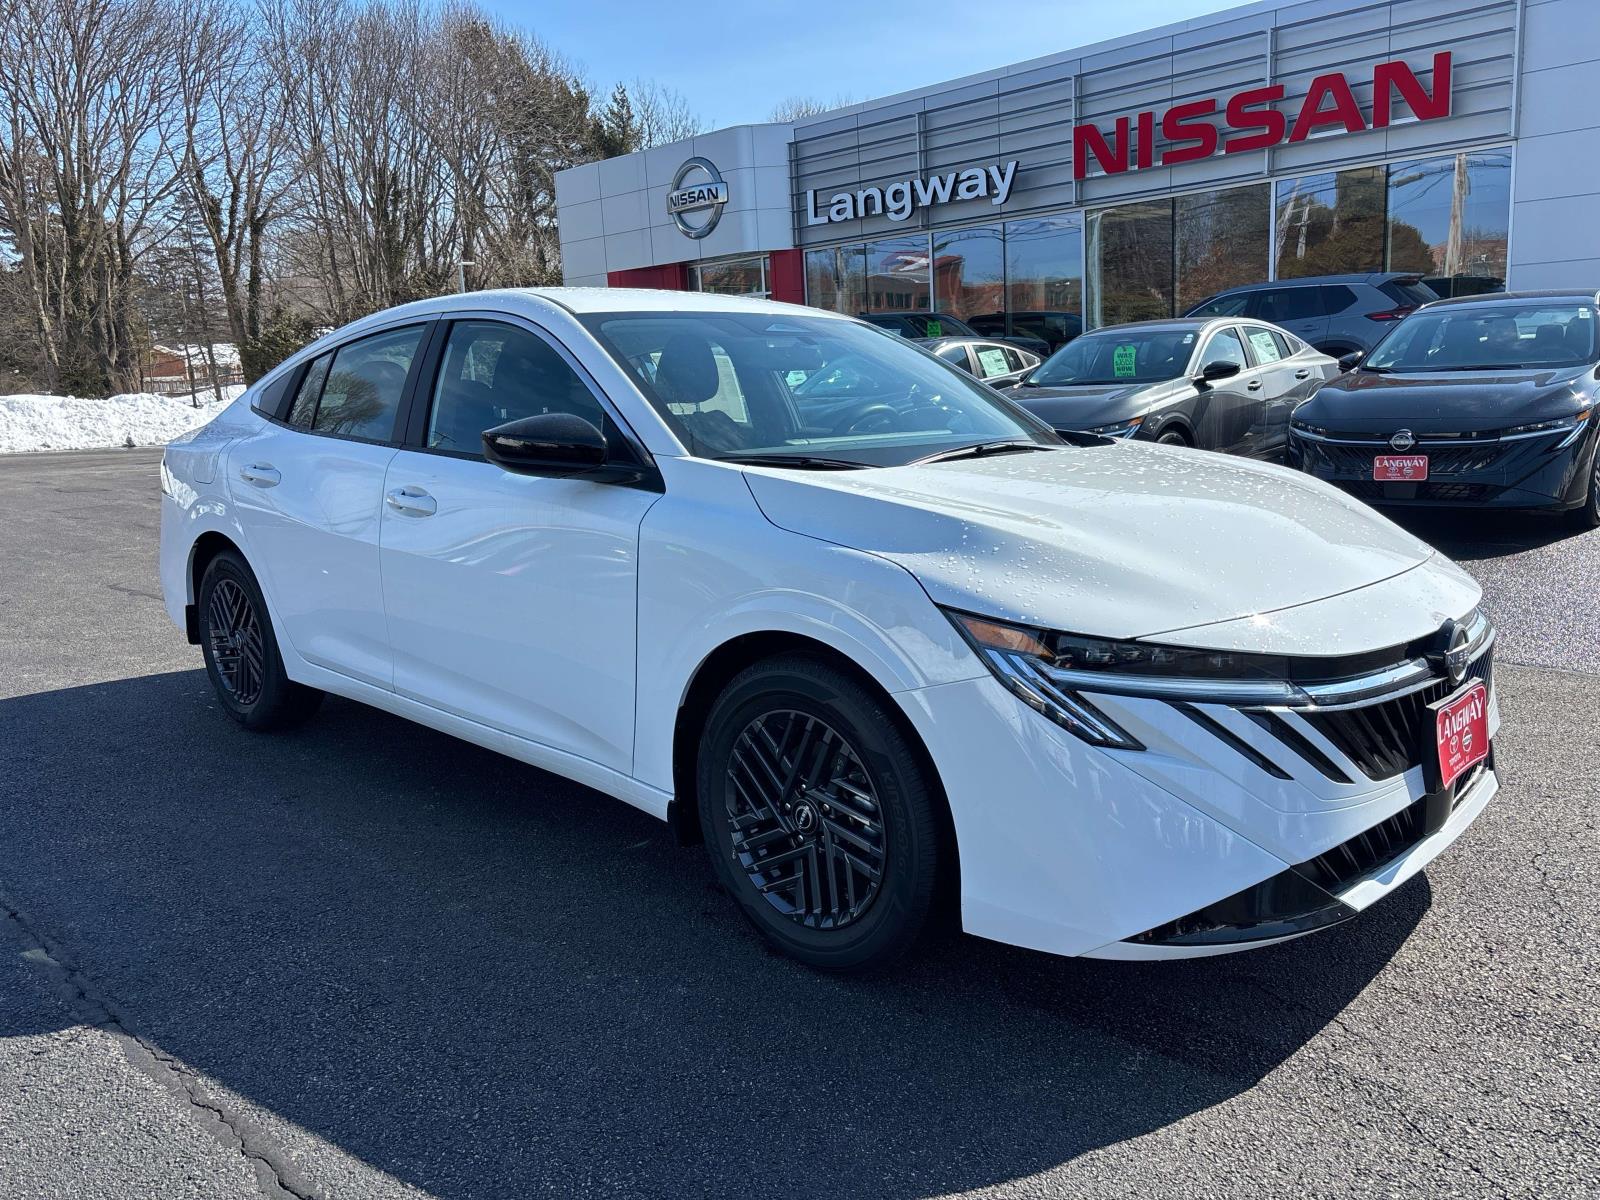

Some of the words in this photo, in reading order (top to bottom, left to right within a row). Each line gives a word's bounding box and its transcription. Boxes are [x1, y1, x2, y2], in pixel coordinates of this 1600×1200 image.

[1073, 51, 1452, 180] NISSAN
[669, 186, 719, 209] NISSAN
[806, 160, 1019, 226] Langway
[1376, 459, 1426, 468] LANGWAY
[1439, 696, 1484, 744] LANGWAY
